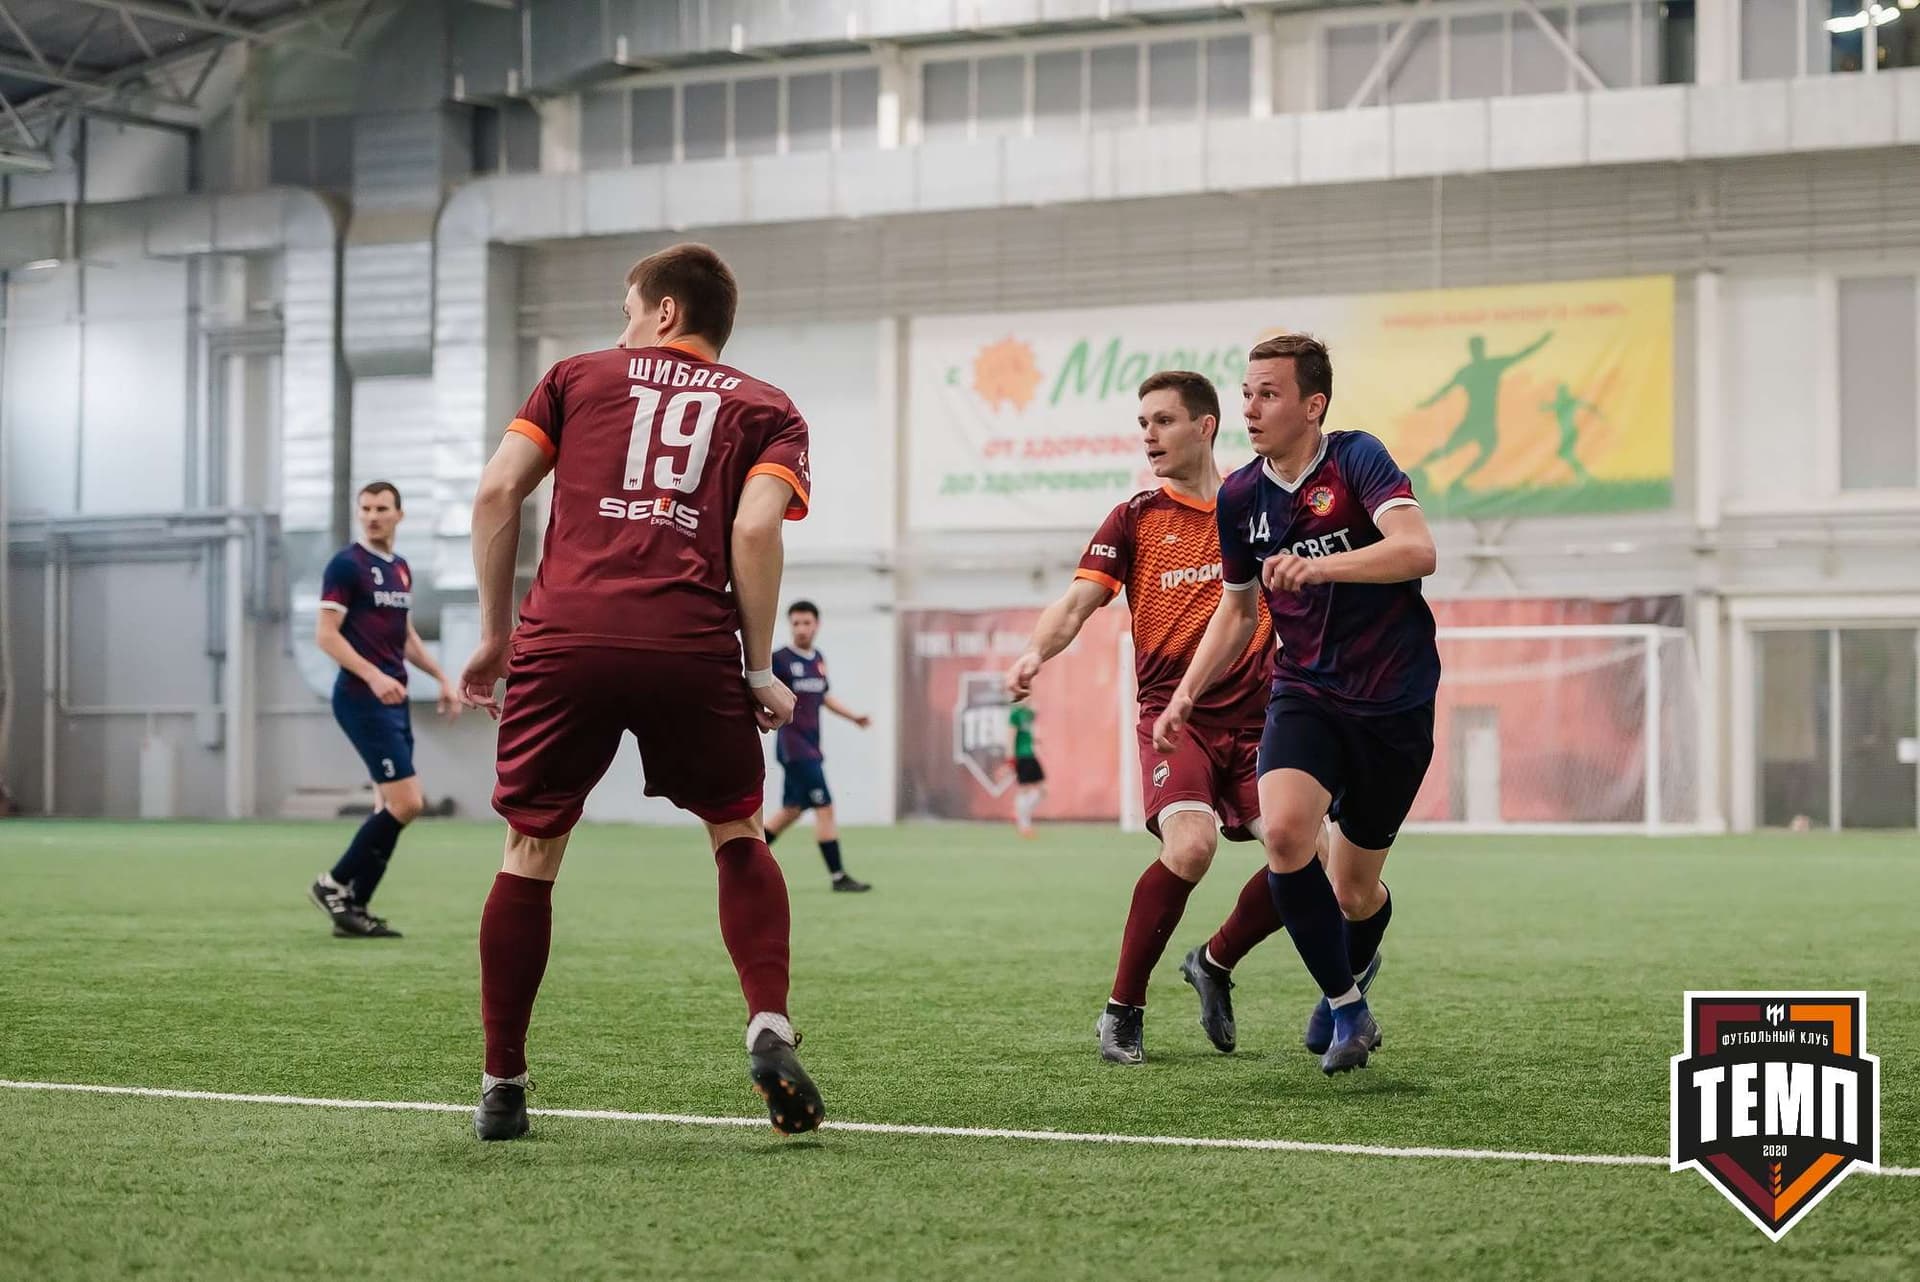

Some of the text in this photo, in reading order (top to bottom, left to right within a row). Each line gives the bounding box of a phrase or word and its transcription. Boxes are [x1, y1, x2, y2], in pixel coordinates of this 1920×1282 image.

[628, 358, 742, 390] ШИБАЕВ
[623, 385, 721, 494] 19
[1249, 511, 1271, 544] 14
[1090, 544, 1117, 558] ПСБ
[1257, 528, 1352, 561] СВЕТ
[371, 566, 384, 586] 3
[1160, 562, 1223, 591] ПРОДИ
[382, 758, 396, 779] 3
